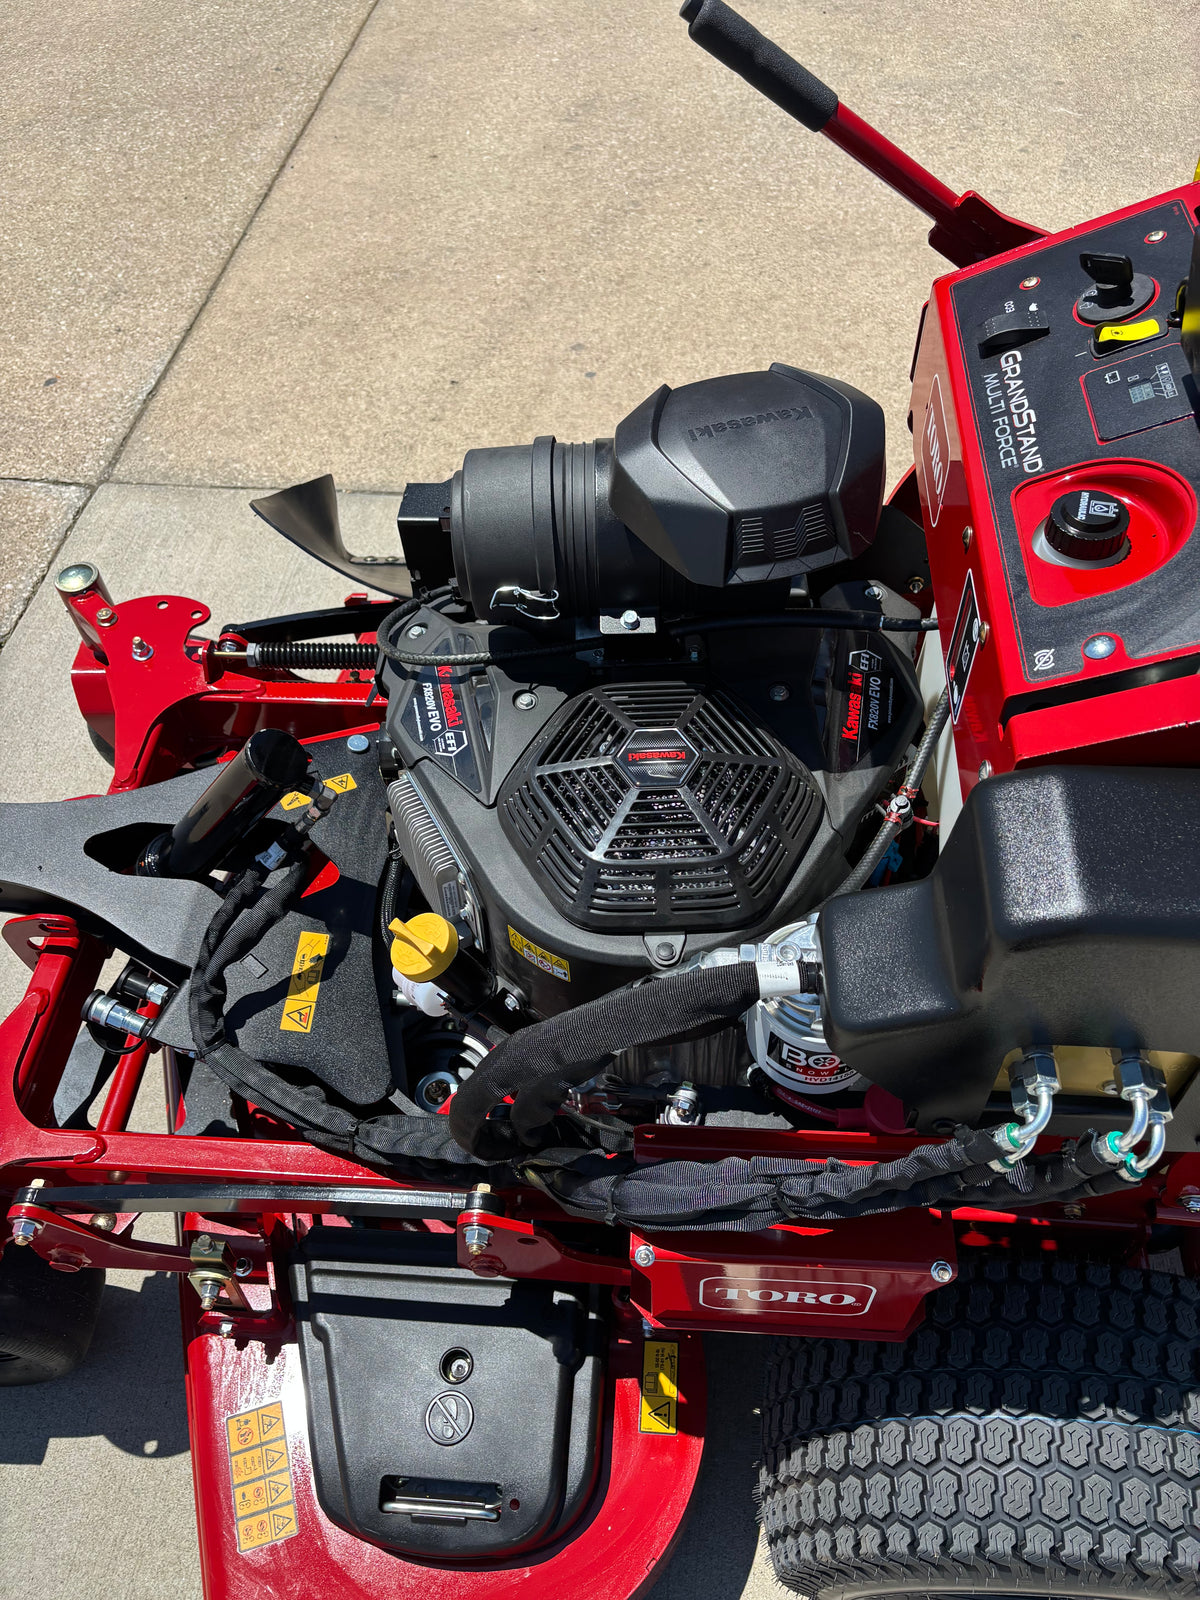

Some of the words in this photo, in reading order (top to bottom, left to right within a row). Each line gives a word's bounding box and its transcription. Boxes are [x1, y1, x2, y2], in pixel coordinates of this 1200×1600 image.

[983, 372, 1006, 415] MULTI
[687, 406, 815, 442] Kawasaki
[927, 402, 943, 495] TORO
[992, 416, 1018, 469] FORCE
[860, 652, 870, 671] EFI
[422, 682, 437, 710] FX820V
[437, 665, 464, 727] Kawasaki
[869, 676, 882, 698] EVO
[427, 710, 442, 732] EVO
[841, 672, 863, 740] Kawasaki
[868, 698, 880, 730] FX820V
[445, 732, 457, 752] EFI
[628, 751, 686, 762] Kawasaki
[715, 1287, 856, 1306] TORO
